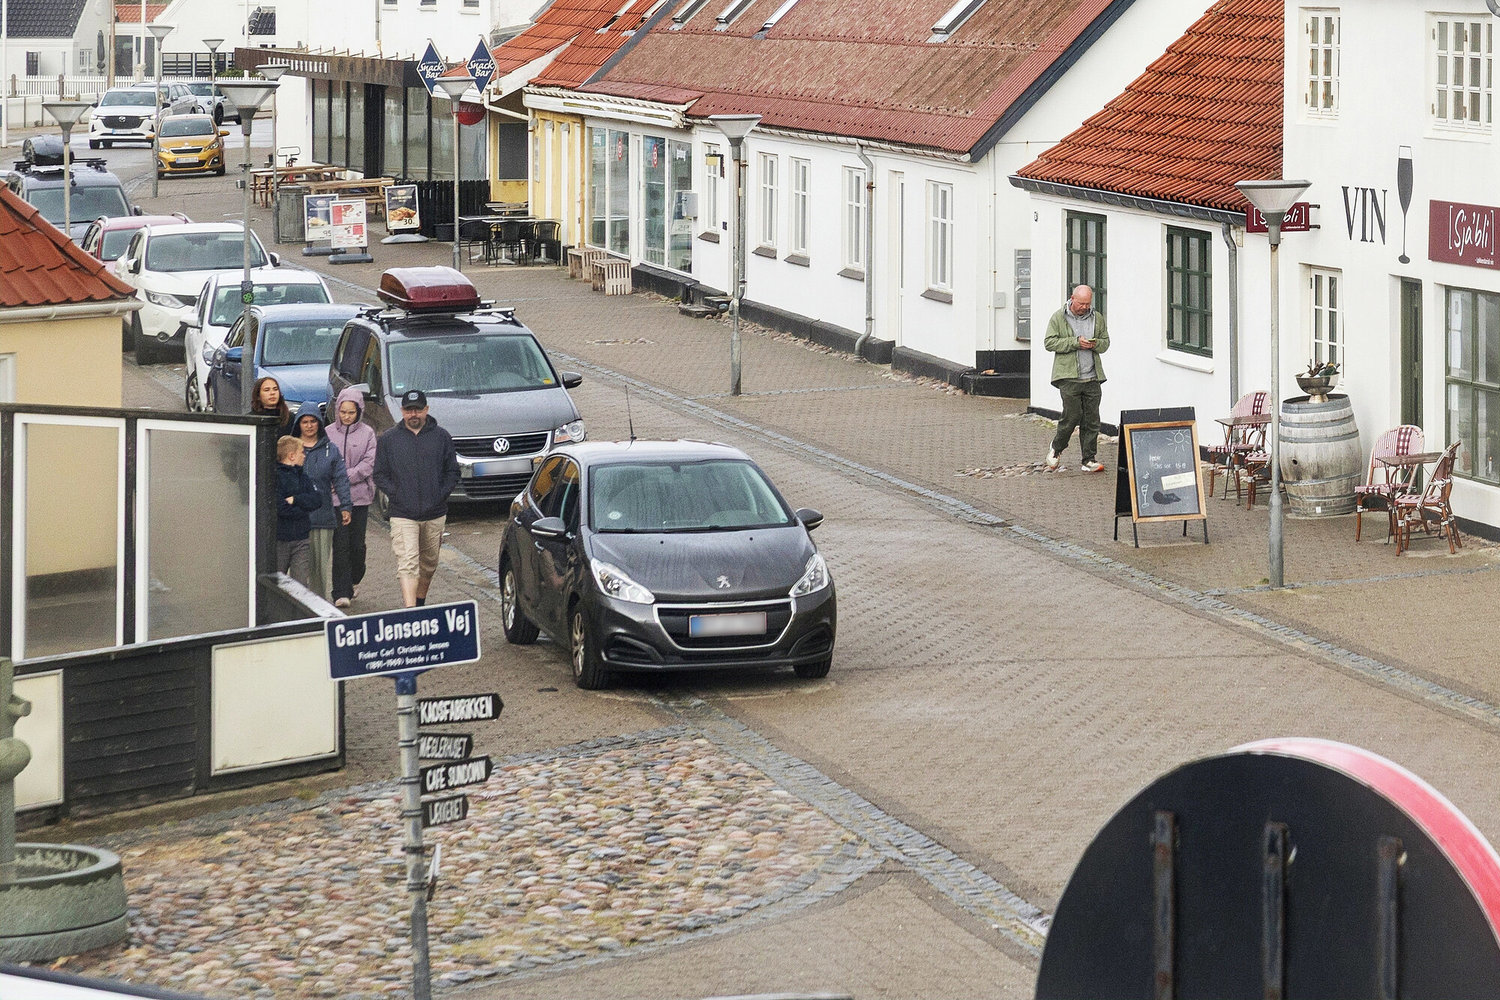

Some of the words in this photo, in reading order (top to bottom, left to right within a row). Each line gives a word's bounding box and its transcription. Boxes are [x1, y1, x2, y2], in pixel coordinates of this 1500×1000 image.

[419, 61, 444, 72] Snack
[468, 59, 495, 70] Snack
[475, 68, 491, 77] Bar
[425, 70, 441, 79] Bar
[1341, 185, 1387, 245] VIN
[335, 620, 368, 648] Carl
[374, 617, 440, 643] Jensens
[444, 608, 471, 636] Vej
[379, 647, 395, 658] Carl
[396, 643, 427, 656] Christian
[428, 641, 450, 651] Jensen
[420, 696, 493, 724] KAOSFABRIKKEN
[426, 764, 446, 792] CAFÉ
